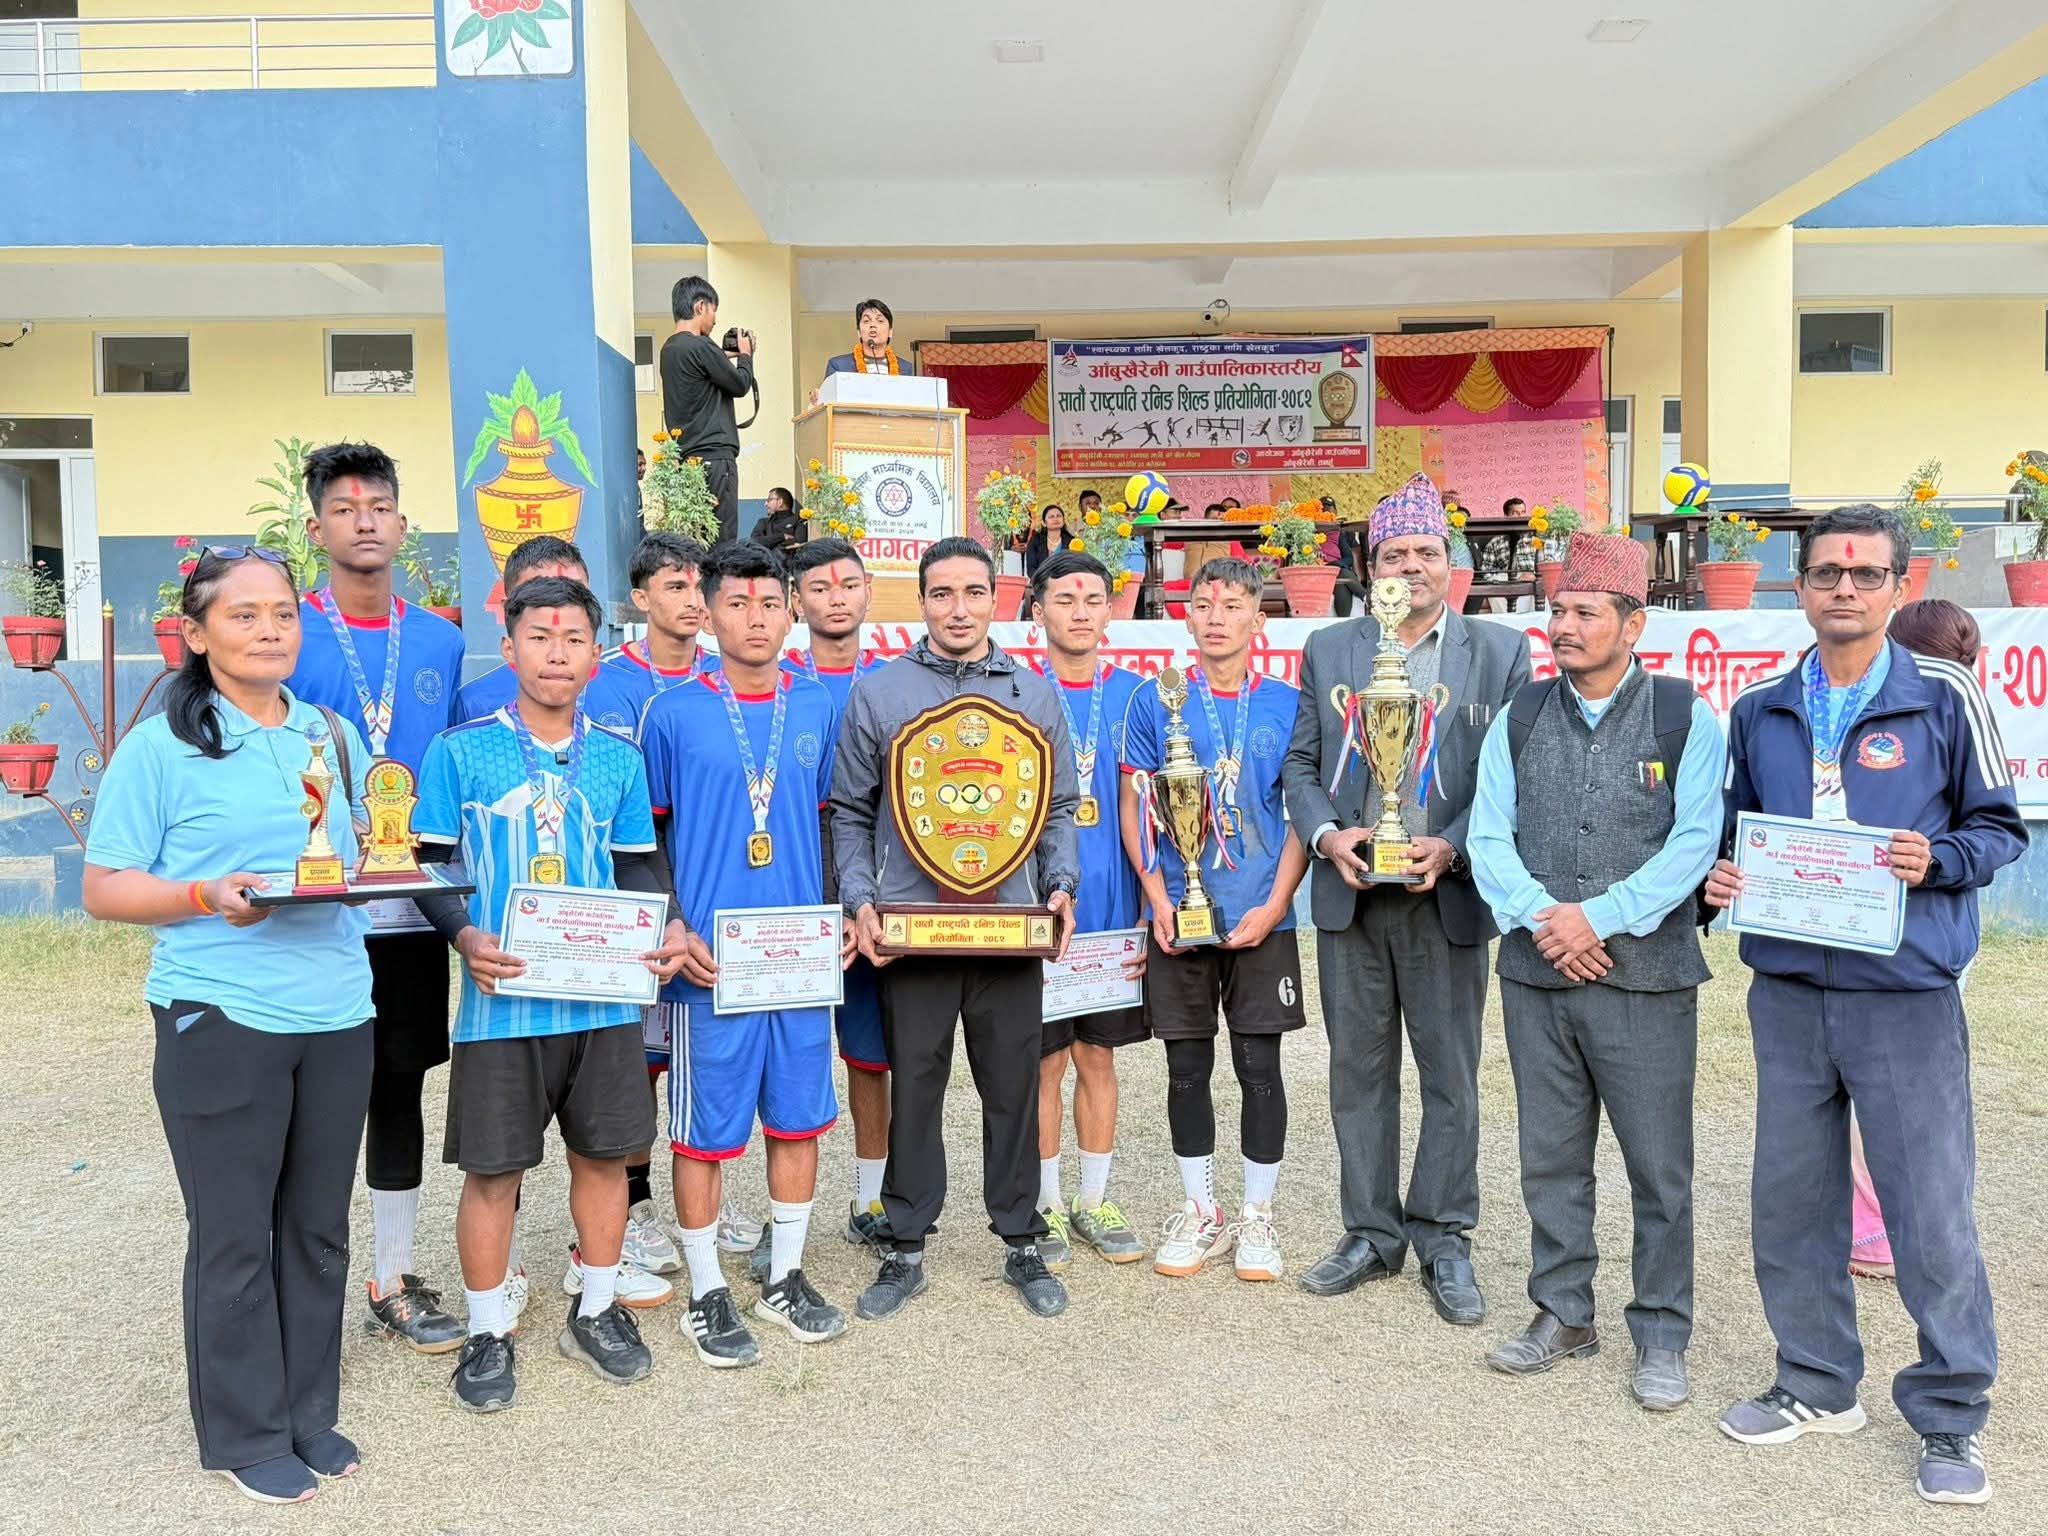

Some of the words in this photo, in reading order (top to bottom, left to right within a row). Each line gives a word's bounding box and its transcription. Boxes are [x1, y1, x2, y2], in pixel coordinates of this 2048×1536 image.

[1175, 358, 1322, 378] गाउँपालिकास्तरीय
[1090, 384, 1138, 417] राष्ट्रपति
[1141, 384, 1174, 413] रनिङ
[1177, 383, 1210, 412] शिल्ड
[872, 459, 915, 477] माध्यमिक
[850, 537, 937, 561] वागत
[1278, 976, 1296, 1007] 6
